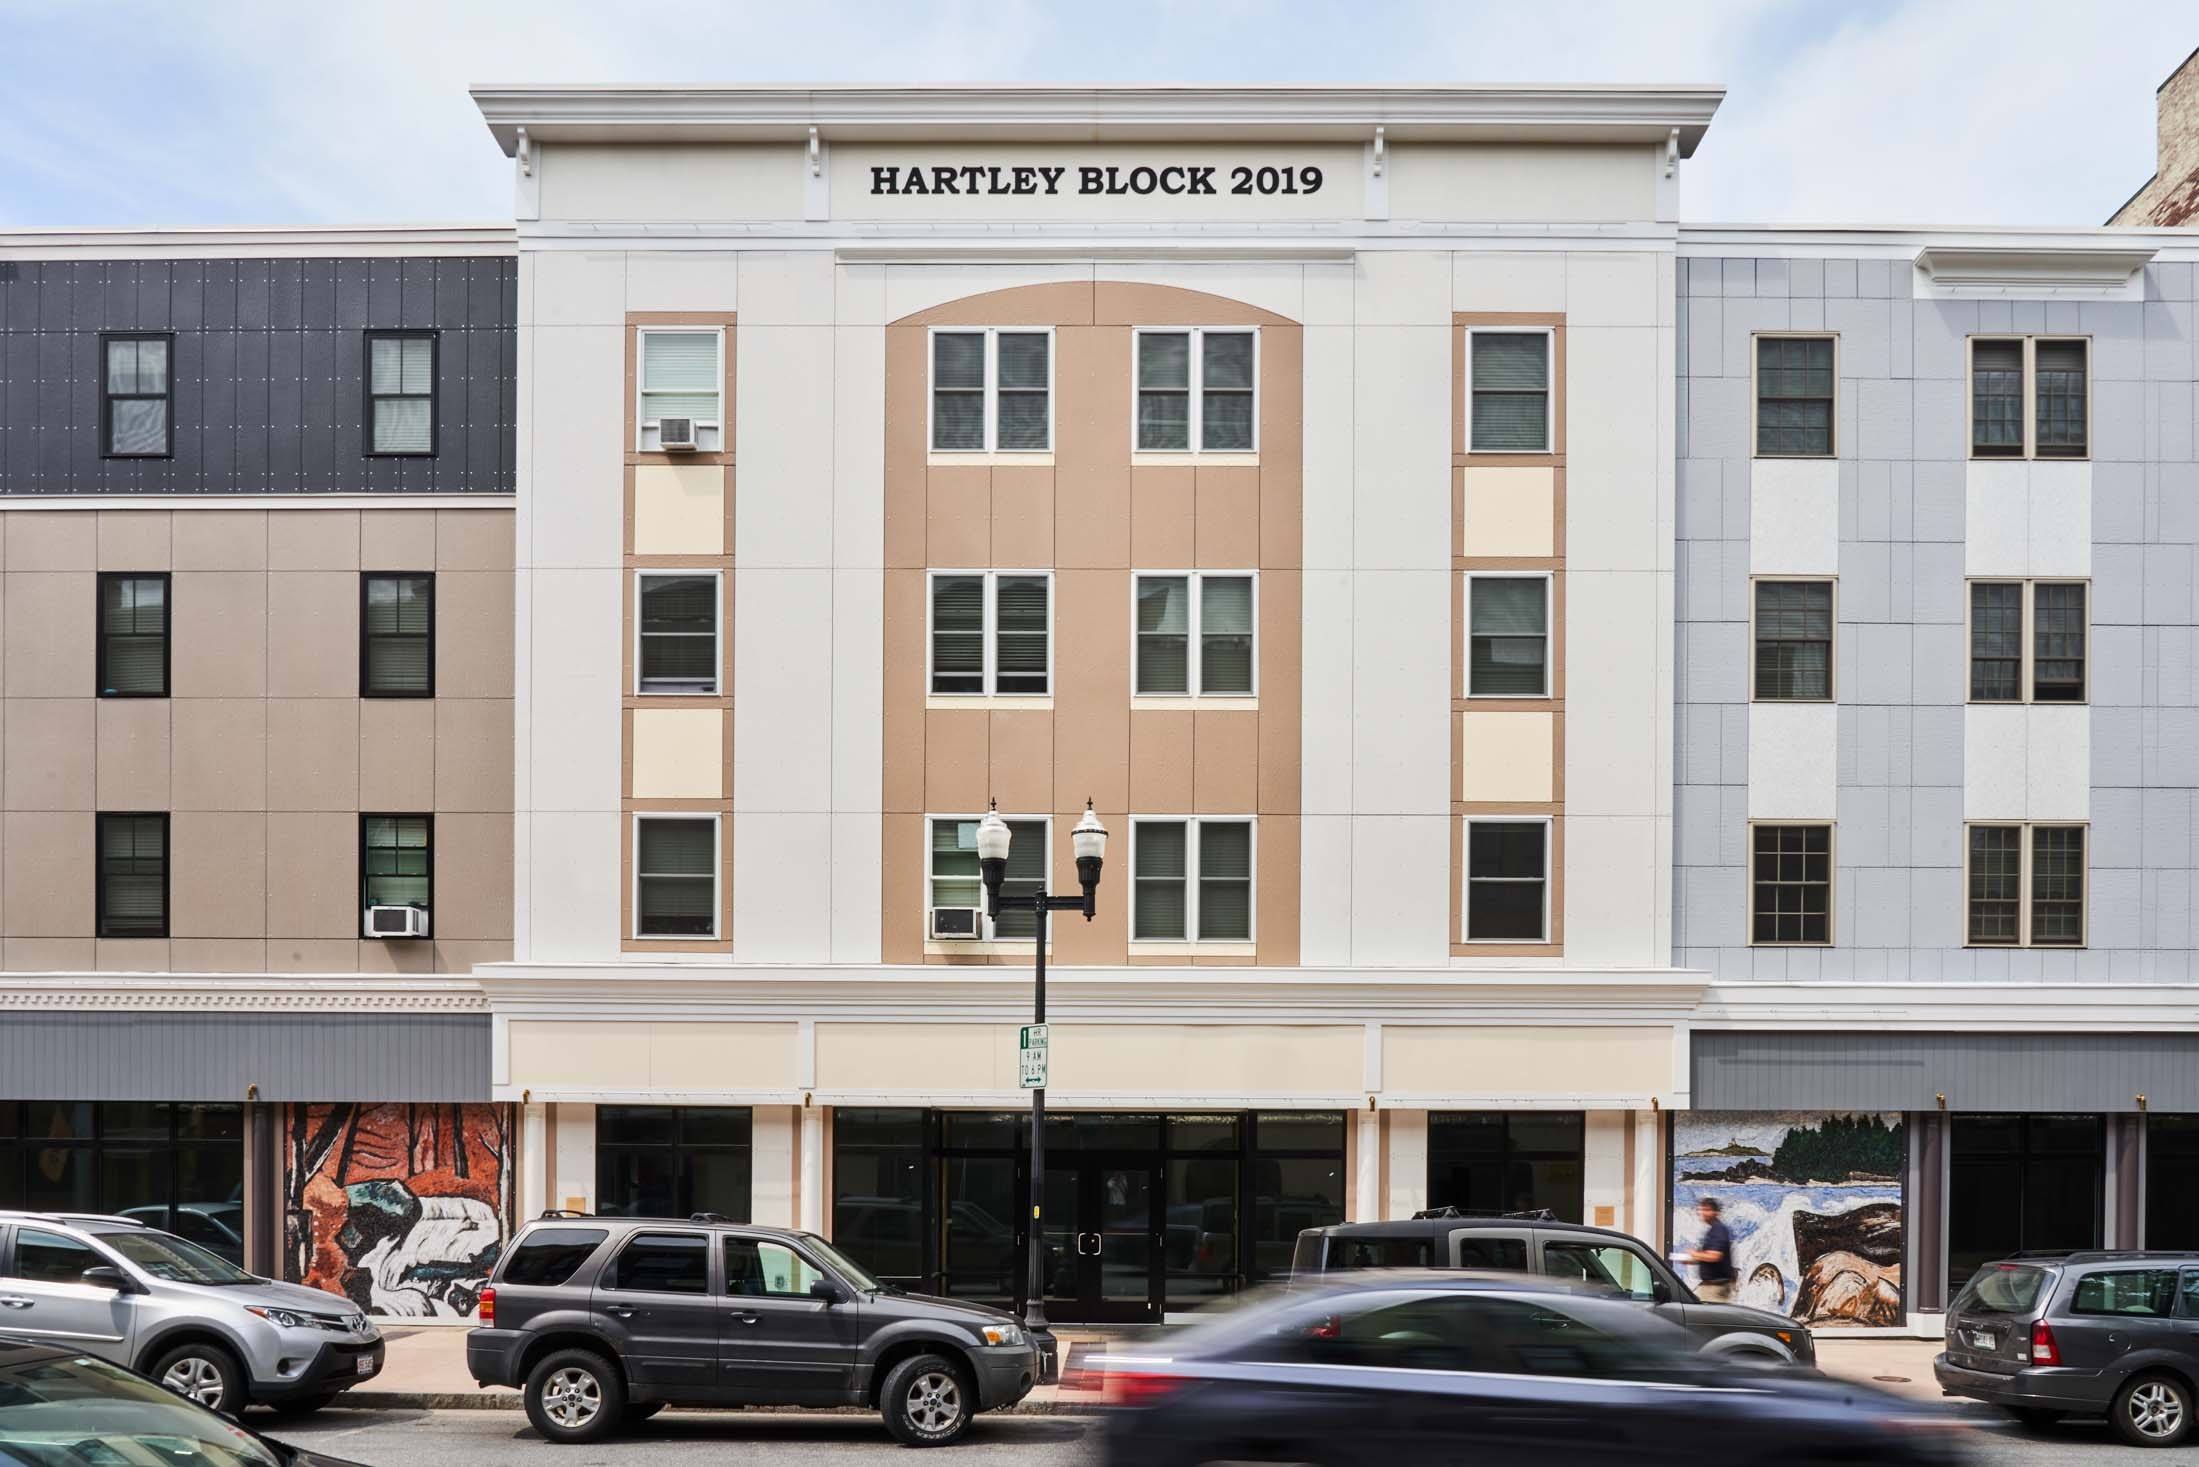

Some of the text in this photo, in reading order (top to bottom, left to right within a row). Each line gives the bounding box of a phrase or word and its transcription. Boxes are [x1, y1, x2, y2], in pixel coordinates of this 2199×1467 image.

[871, 166, 1323, 195] HARTLEY BLOCK 2019
[1033, 1028, 1042, 1036] HR
[1033, 1050, 1042, 1061] AM
[1021, 1064, 1029, 1076] TO
[1037, 1063, 1046, 1074] PM
